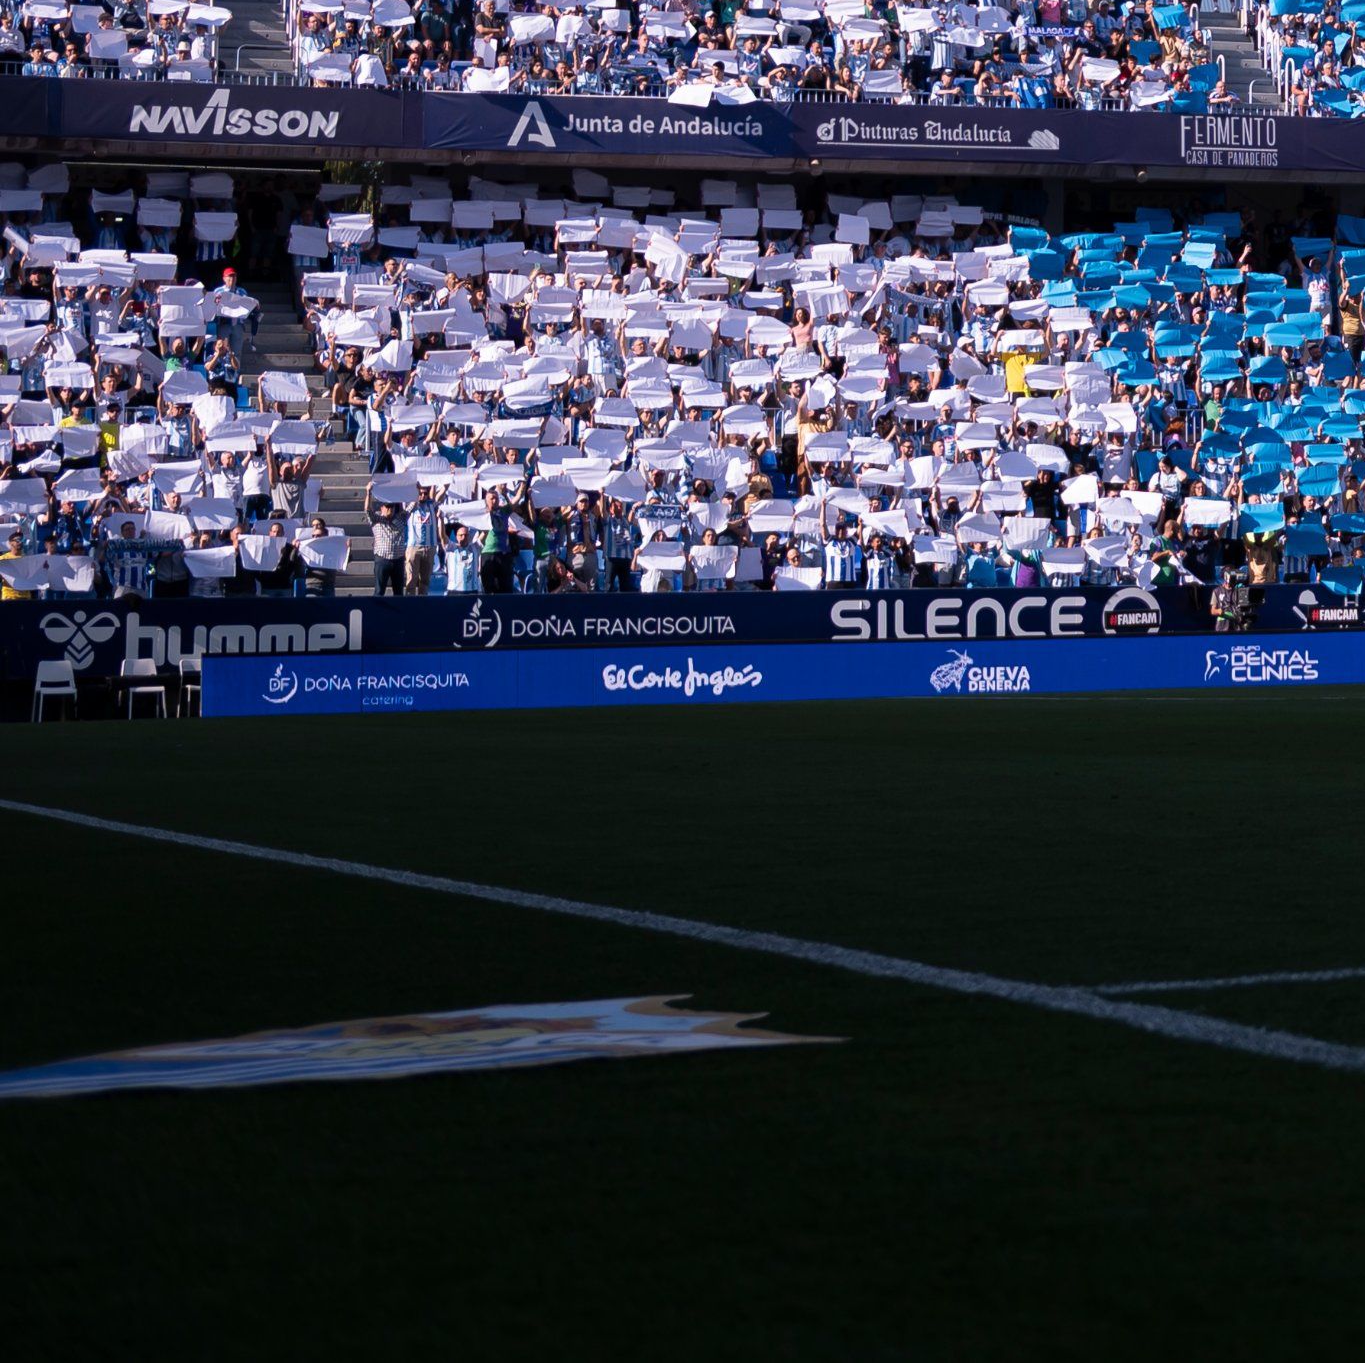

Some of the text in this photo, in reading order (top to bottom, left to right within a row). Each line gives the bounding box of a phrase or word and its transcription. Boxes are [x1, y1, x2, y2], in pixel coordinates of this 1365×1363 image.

[129, 88, 338, 138] NAVISSON
[563, 113, 763, 136] Junta de Andalucía
[839, 117, 918, 142] Pinturas
[924, 120, 1012, 142] Andalucía
[1181, 116, 1276, 157] FERMENTO
[1186, 151, 1278, 166] CASA DE PANADEROS
[830, 595, 1086, 640] SILENCE
[1109, 612, 1157, 626] #FANCAM
[1312, 608, 1358, 621] #FANCAM
[1231, 650, 1319, 666] DENTAL
[357, 673, 470, 690] FRANCISQUITA
[602, 664, 626, 690] El
[628, 664, 682, 689] Corte
[968, 666, 1030, 681] CUEVA
[1231, 665, 1319, 682] CLINICS
[362, 695, 414, 706] catering
